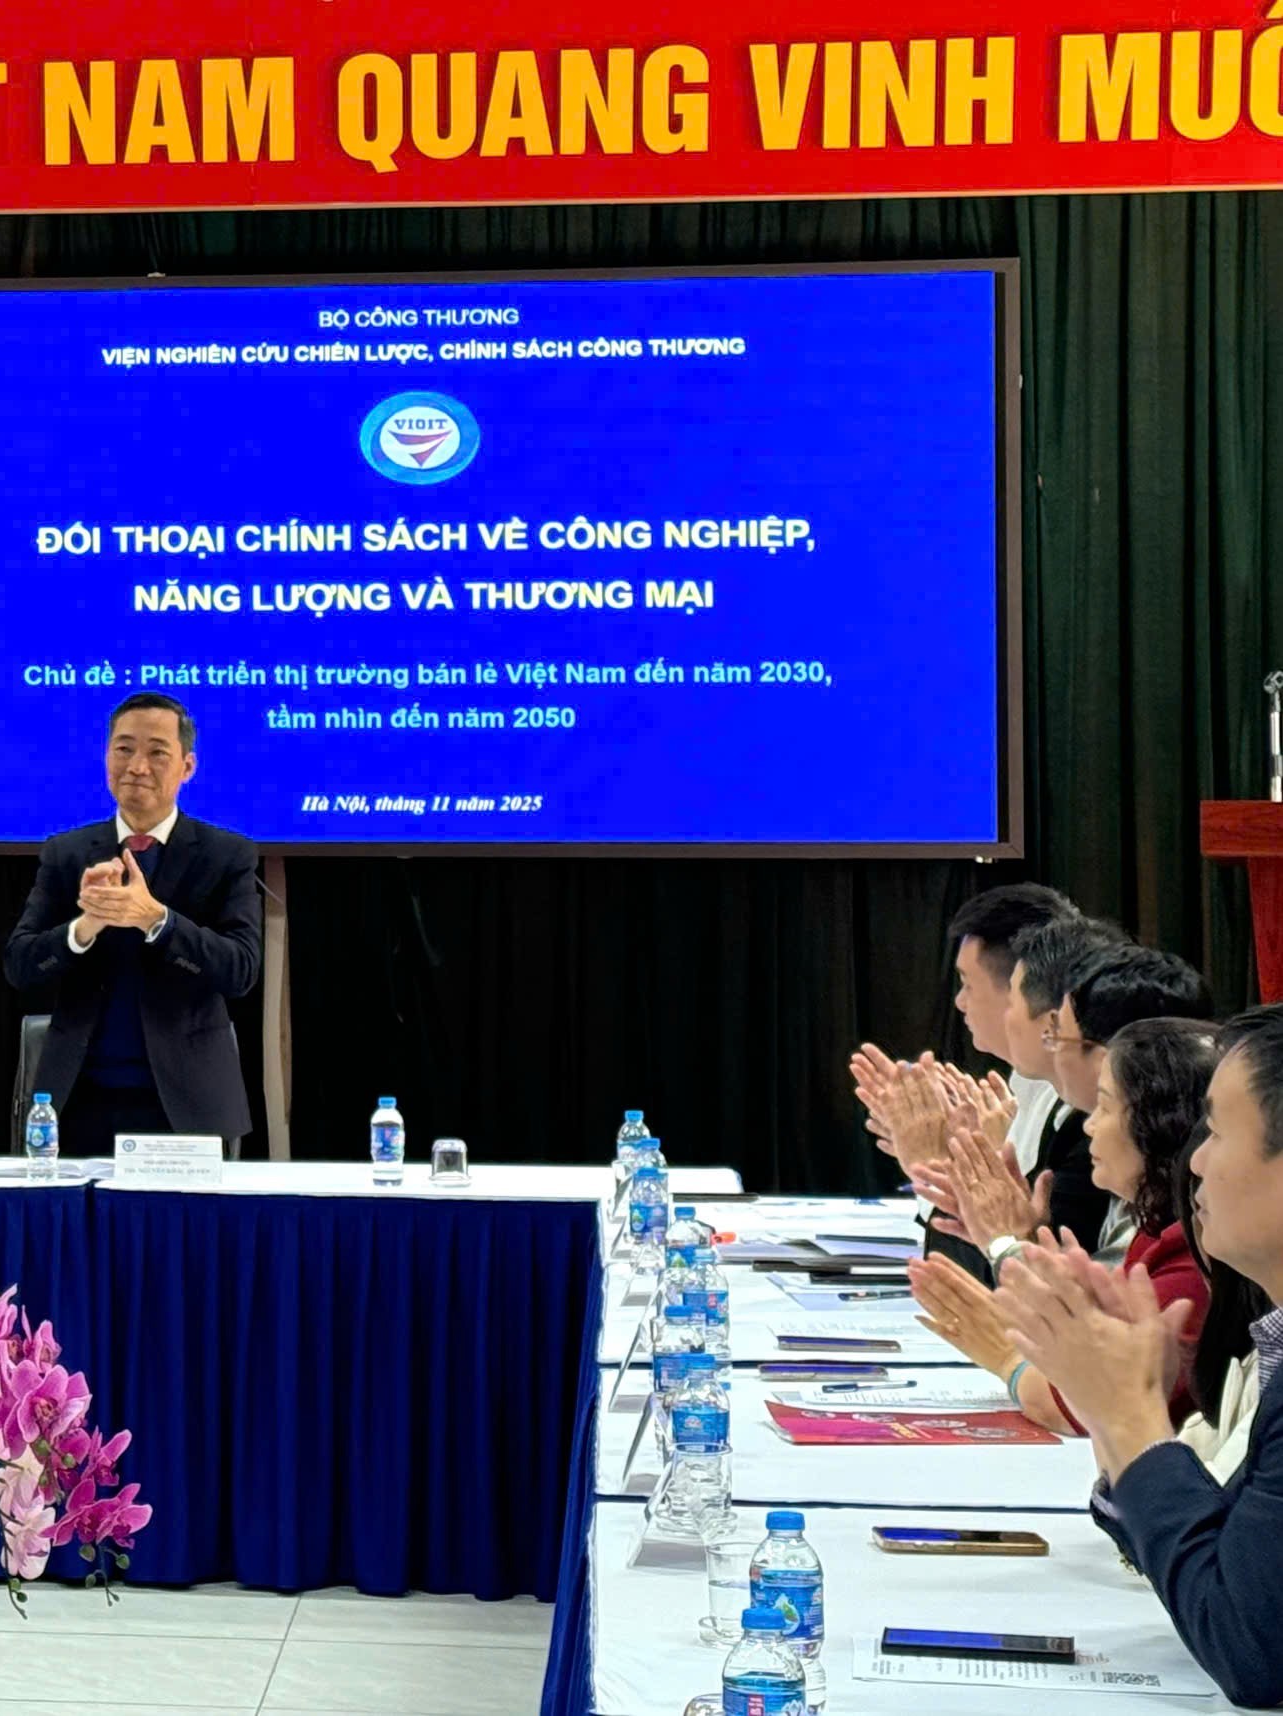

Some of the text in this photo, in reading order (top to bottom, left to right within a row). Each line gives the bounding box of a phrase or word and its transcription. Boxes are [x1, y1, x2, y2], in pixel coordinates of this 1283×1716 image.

[44, 56, 296, 165] NAM
[338, 45, 709, 173] QUANG
[750, 36, 1015, 151] VINH
[318, 305, 520, 331] BỘ CÔNG THƯƠNG
[155, 343, 237, 365] NGHIÊN
[240, 341, 290, 364] CỨU
[364, 343, 434, 365] LƯỢC,
[438, 338, 507, 361] CHÍNH
[511, 337, 574, 360] SÁCH
[576, 336, 643, 358] CÔNG
[647, 336, 746, 357] THƯƠNG
[112, 524, 226, 560] THOẠI
[235, 518, 352, 553] CHÍNH
[363, 516, 468, 553] SÁCH
[538, 514, 653, 551] CÔNG
[663, 514, 815, 555] NGHIỆP,
[133, 575, 714, 618] NĂNG LƯỢNG VÀ THƯƠNG MẠI
[23, 662, 77, 686] Chủ
[140, 663, 201, 686] Phát
[273, 664, 308, 691] thị
[314, 663, 410, 690] trường
[417, 662, 467, 685] bán
[475, 661, 499, 684] lẻ
[504, 661, 558, 690] Việt
[565, 662, 626, 684] Nam
[633, 656, 685, 684] đến
[693, 661, 752, 683] năm
[759, 661, 833, 687] 2030,
[266, 702, 576, 729] tầm nhìn đến năm 2050
[301, 795, 543, 816] Hà Nội, tháng 11 năm 2025
